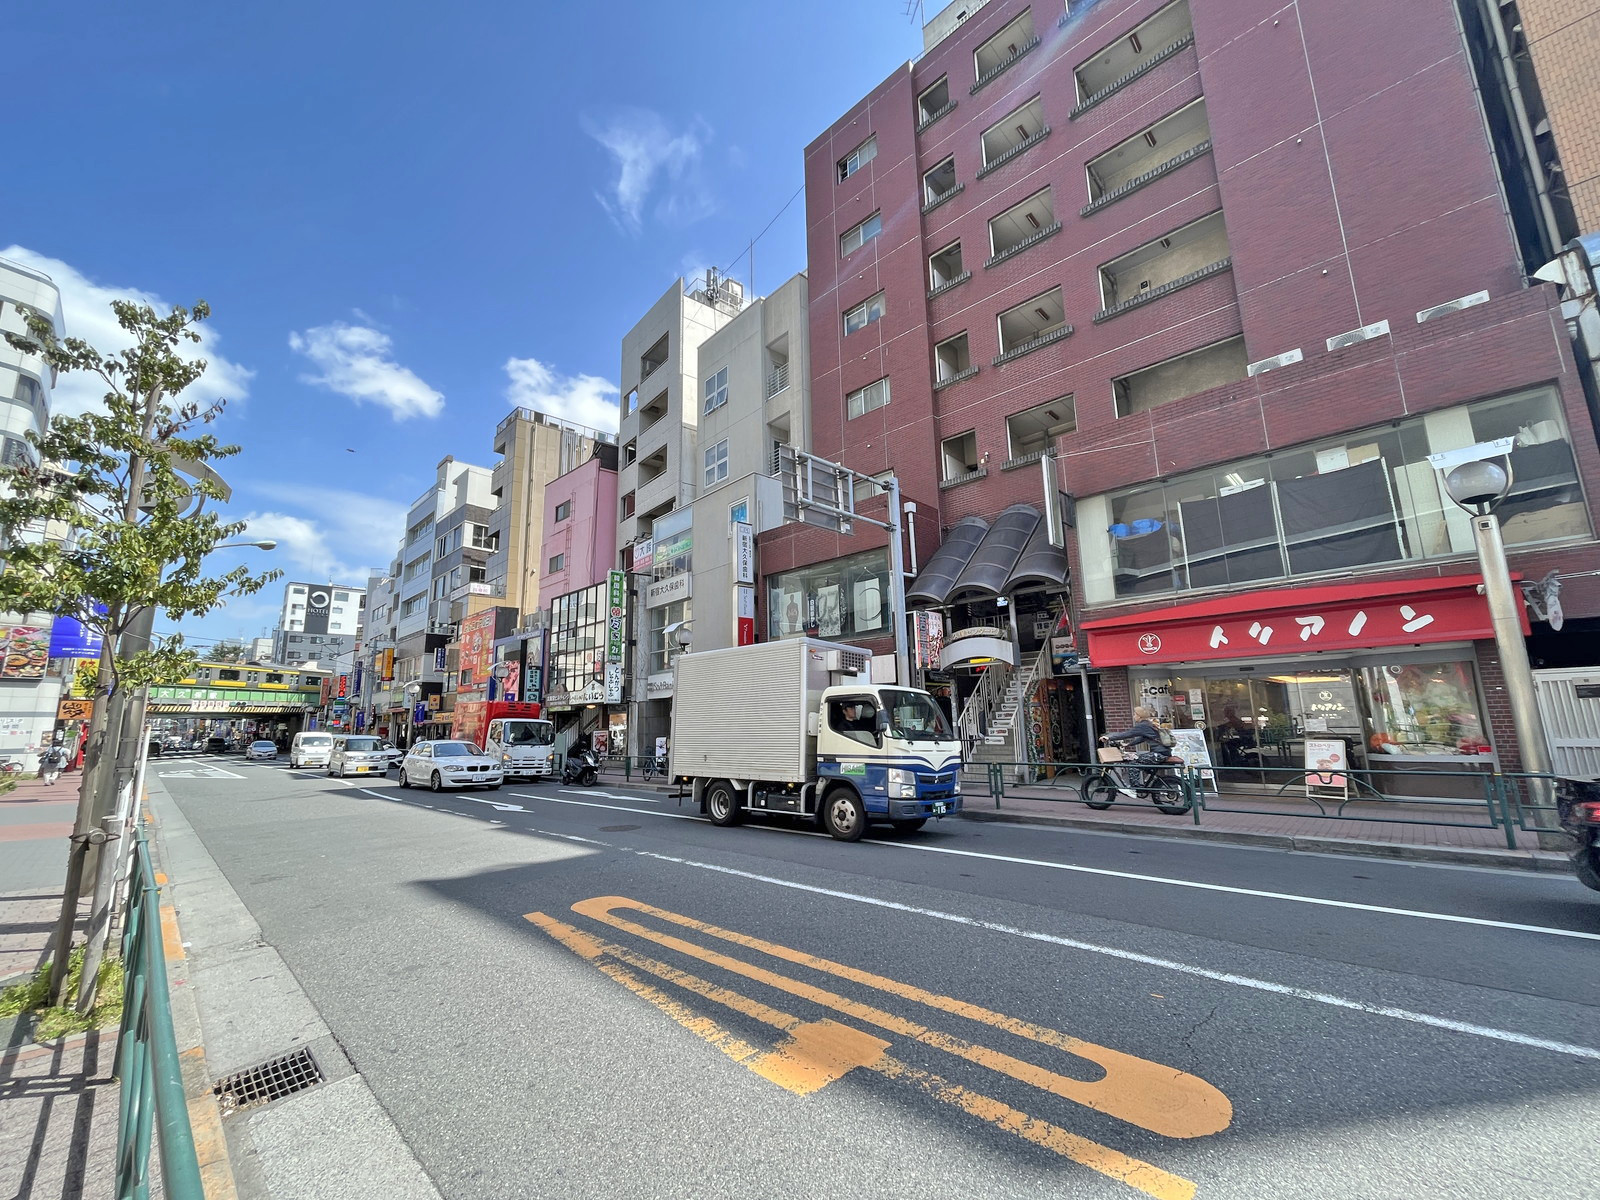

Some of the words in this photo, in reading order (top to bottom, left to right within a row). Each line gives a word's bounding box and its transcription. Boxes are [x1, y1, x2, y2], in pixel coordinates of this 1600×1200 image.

[650, 579, 685, 597] 新宿大久保歯科
[160, 690, 218, 699] 大久保駅
